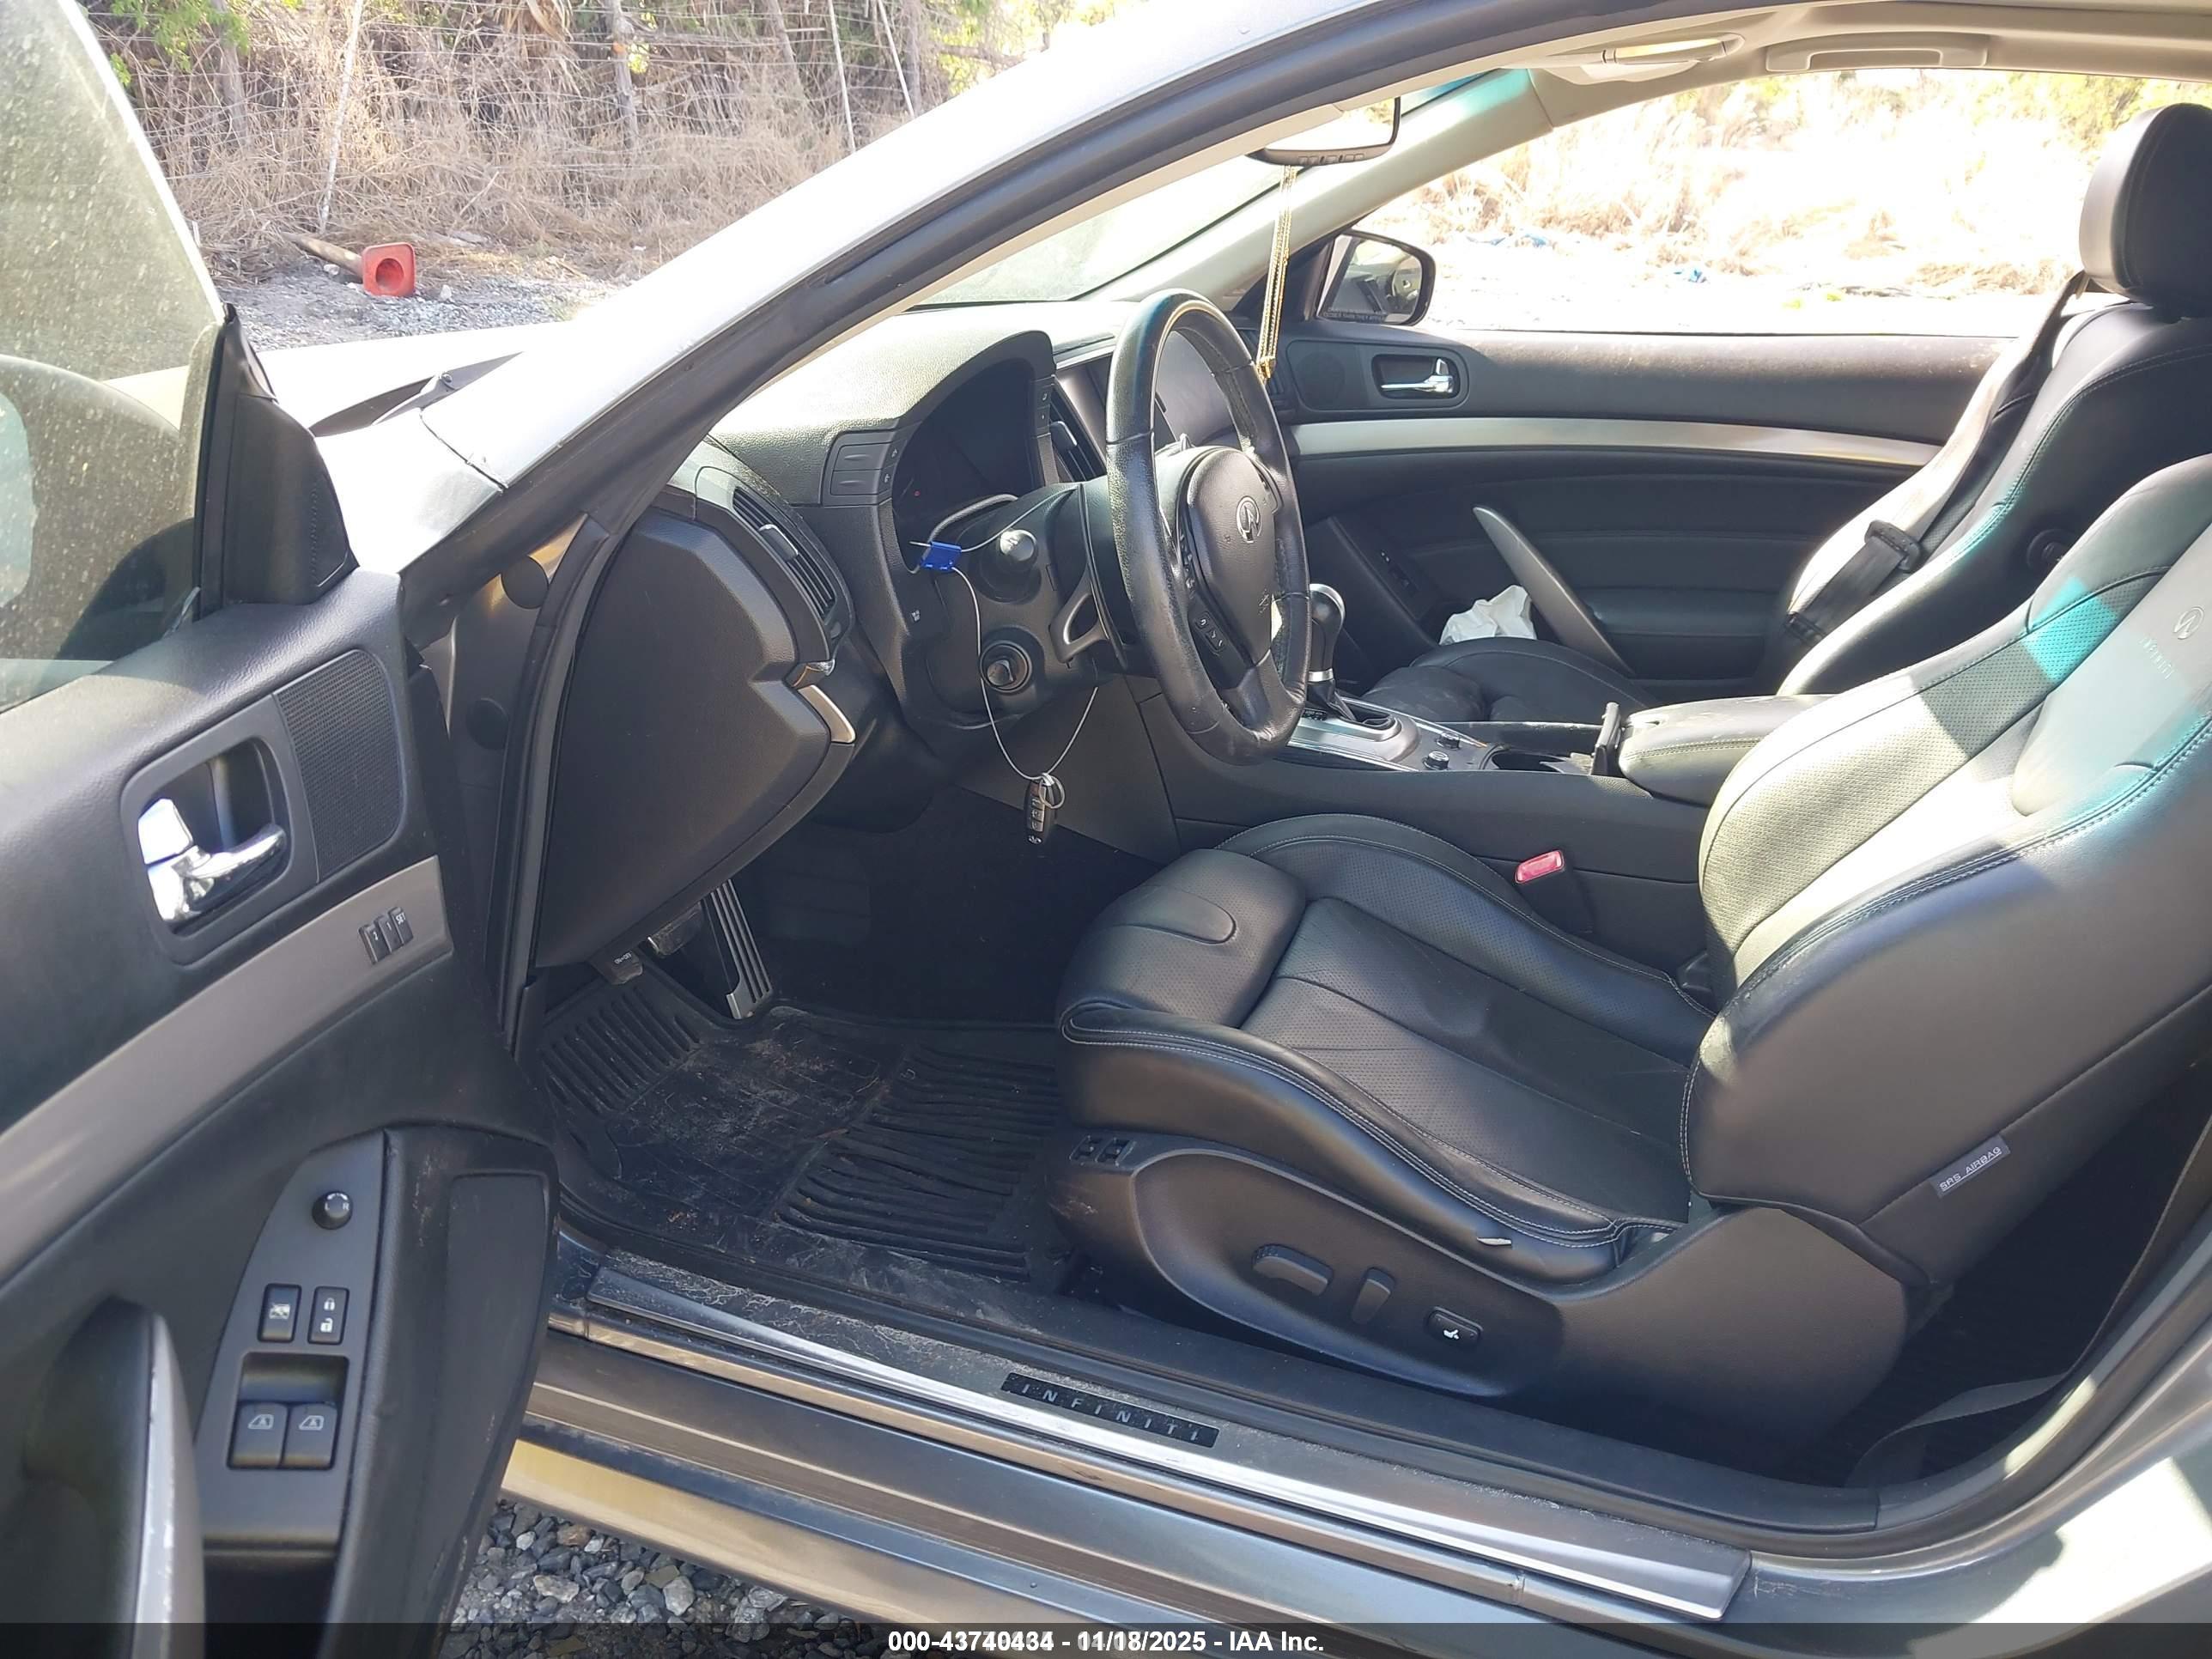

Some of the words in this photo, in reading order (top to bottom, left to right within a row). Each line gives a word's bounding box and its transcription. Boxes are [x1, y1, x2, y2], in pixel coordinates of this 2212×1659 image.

[1940, 1173, 1961, 1190] SRS
[1966, 1146, 2002, 1174] AIRBAG
[324, 1201, 331, 1212] L
[343, 1201, 350, 1212] R
[1021, 1383, 1199, 1442] INFINITI
